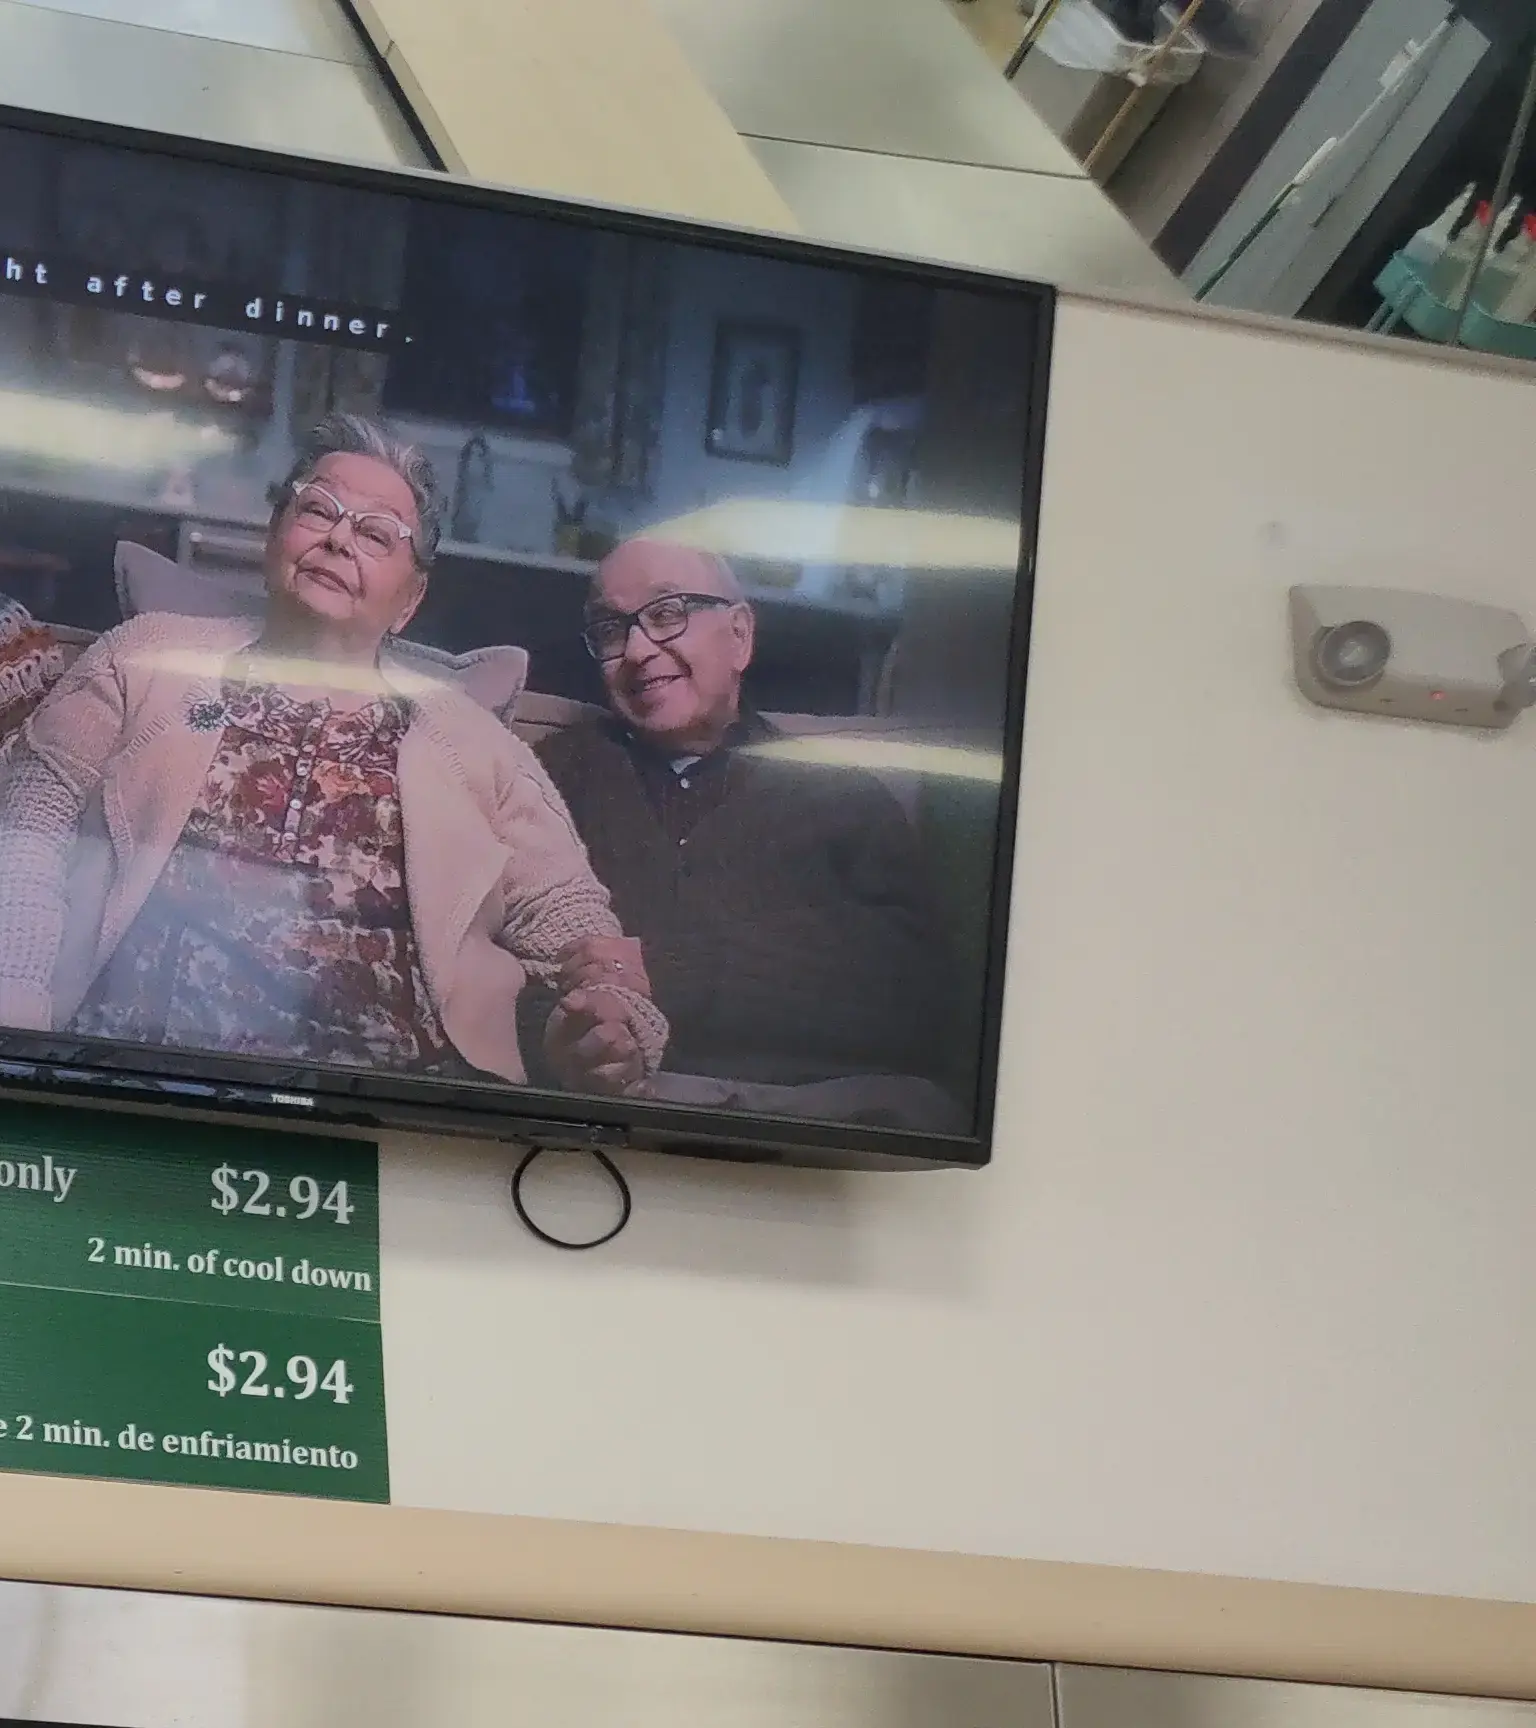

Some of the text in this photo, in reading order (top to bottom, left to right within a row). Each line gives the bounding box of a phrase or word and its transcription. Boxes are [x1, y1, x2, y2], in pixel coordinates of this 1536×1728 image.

[86, 273, 207, 310] after
[244, 298, 413, 344] dinner.
[271, 1093, 315, 1107] TOSHIBA
[210, 1161, 355, 1225] $2.94
[87, 1237, 372, 1292] 2 min. of cool down
[206, 1342, 354, 1405] $2.94
[14, 1415, 35, 1441] 2
[42, 1419, 111, 1449] min.
[118, 1423, 155, 1452] de
[161, 1430, 359, 1470] enfriamiento
